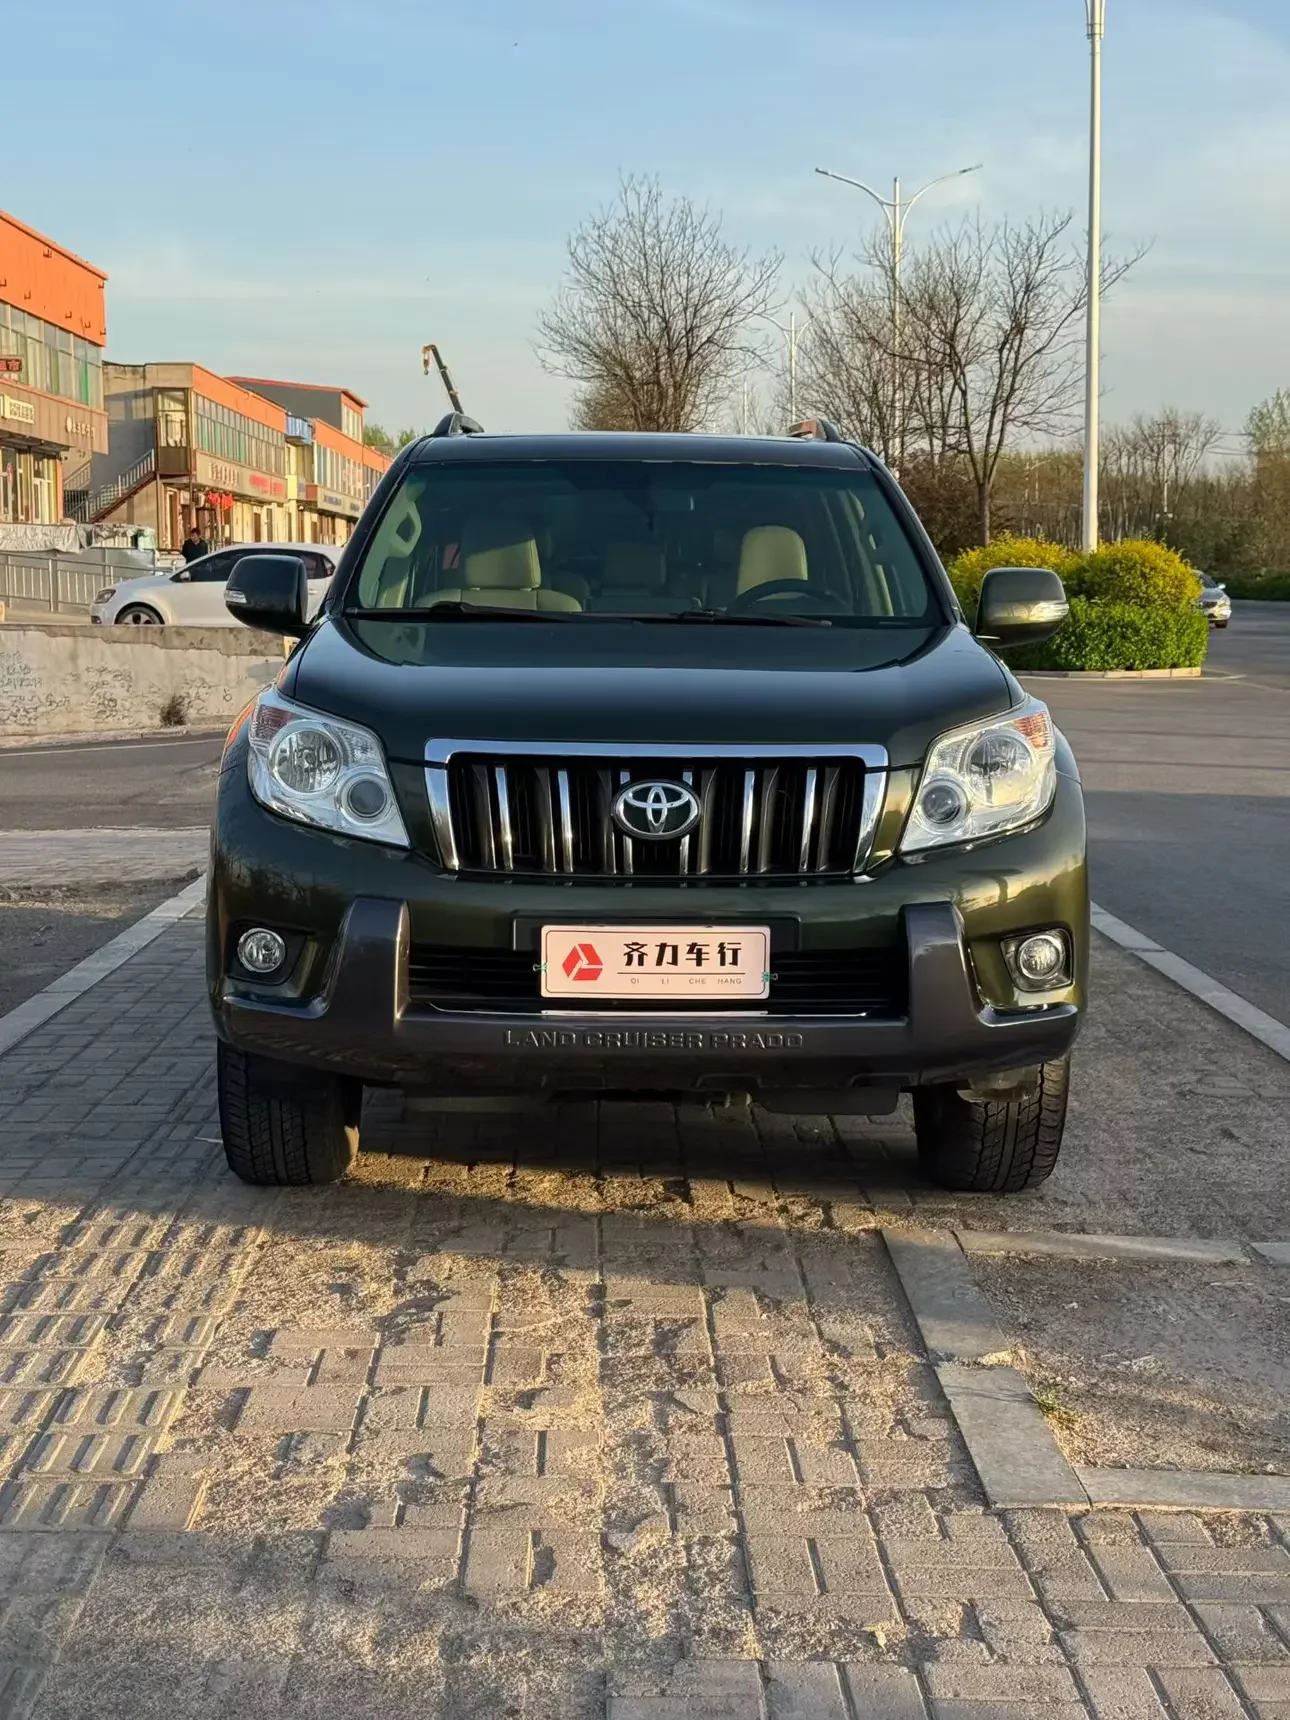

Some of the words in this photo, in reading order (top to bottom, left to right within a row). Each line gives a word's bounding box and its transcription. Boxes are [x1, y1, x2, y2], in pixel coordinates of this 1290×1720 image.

[623, 942, 742, 967] 齐力车行
[504, 1030, 577, 1048] LAND
[583, 1030, 704, 1049] CRUISER
[710, 1031, 803, 1049] PRADO
